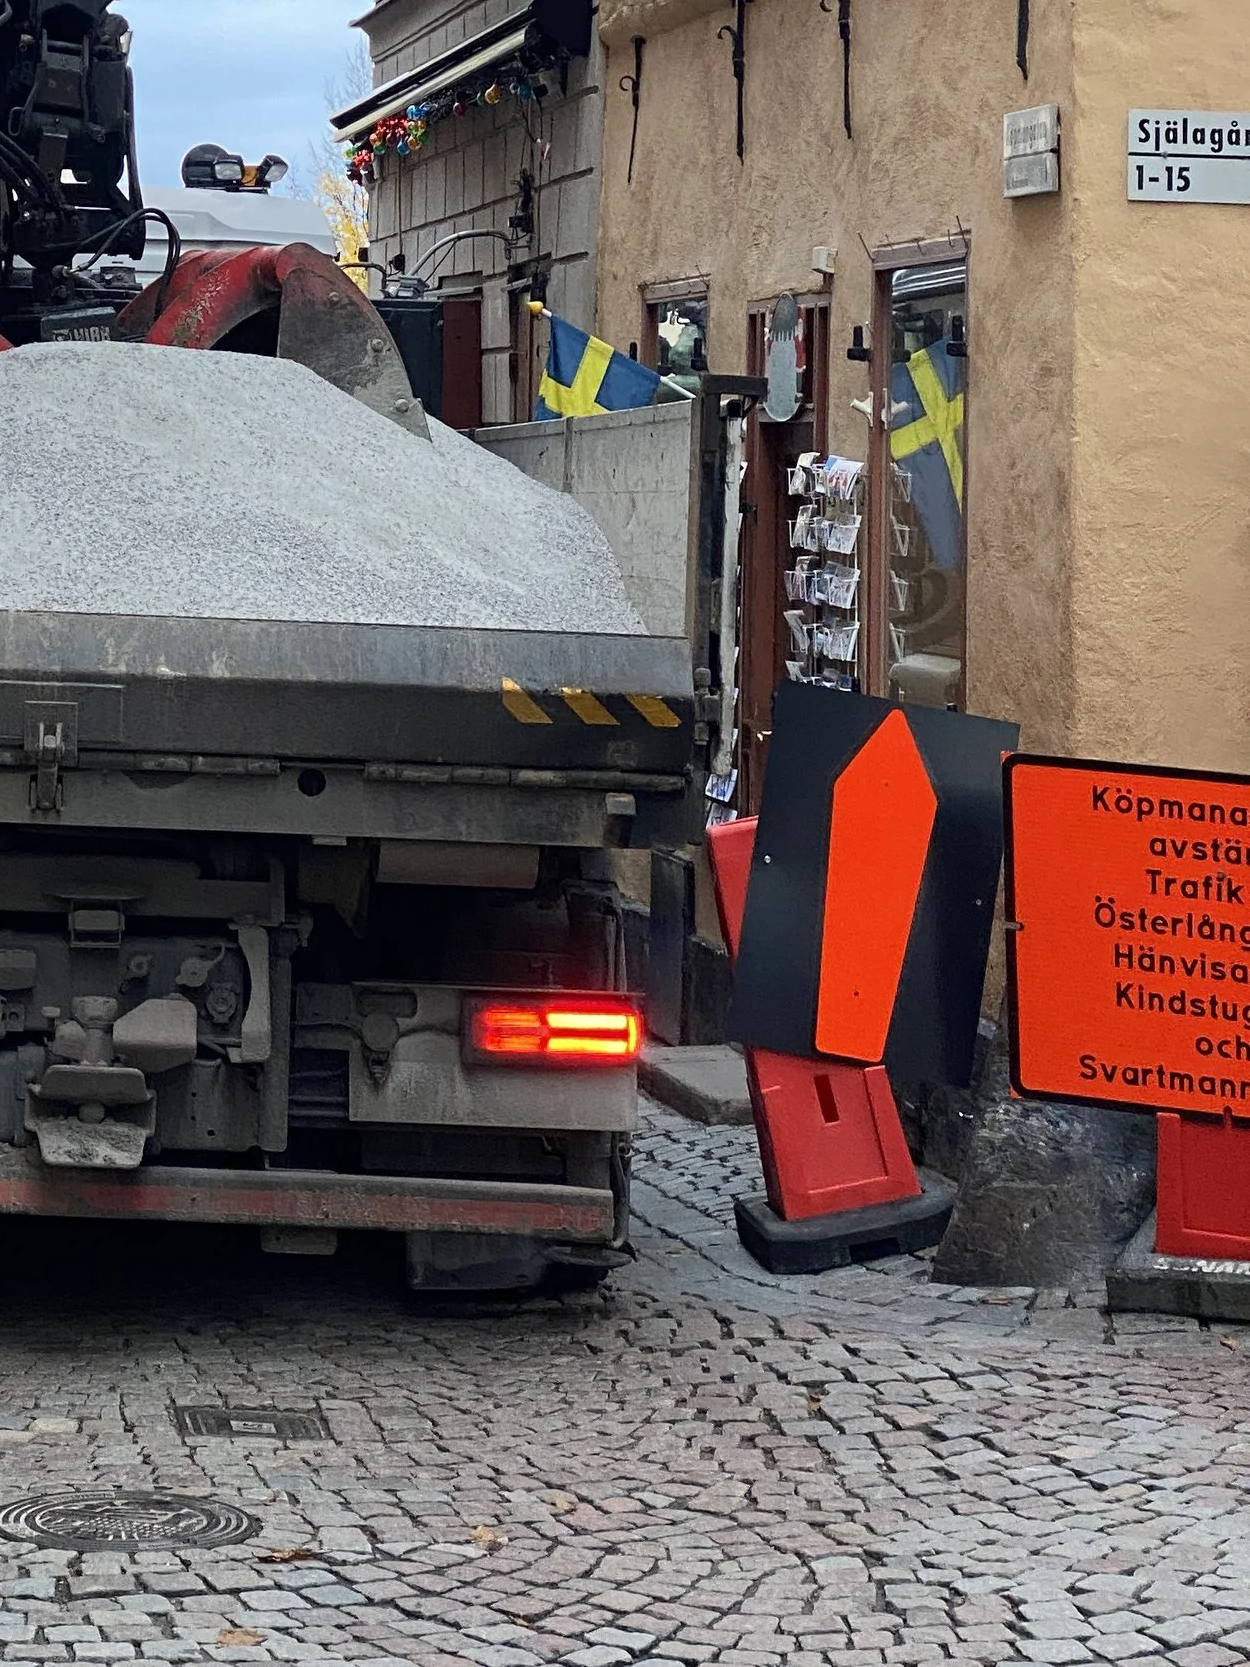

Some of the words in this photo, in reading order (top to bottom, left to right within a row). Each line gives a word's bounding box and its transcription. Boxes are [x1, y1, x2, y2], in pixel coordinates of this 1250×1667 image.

[1136, 164, 1192, 192] 1-15
[1091, 785, 1248, 827] Köpmana
[1145, 868, 1245, 905] Trafik
[1113, 943, 1248, 984] Hänvisa
[1195, 1034, 1250, 1062] och
